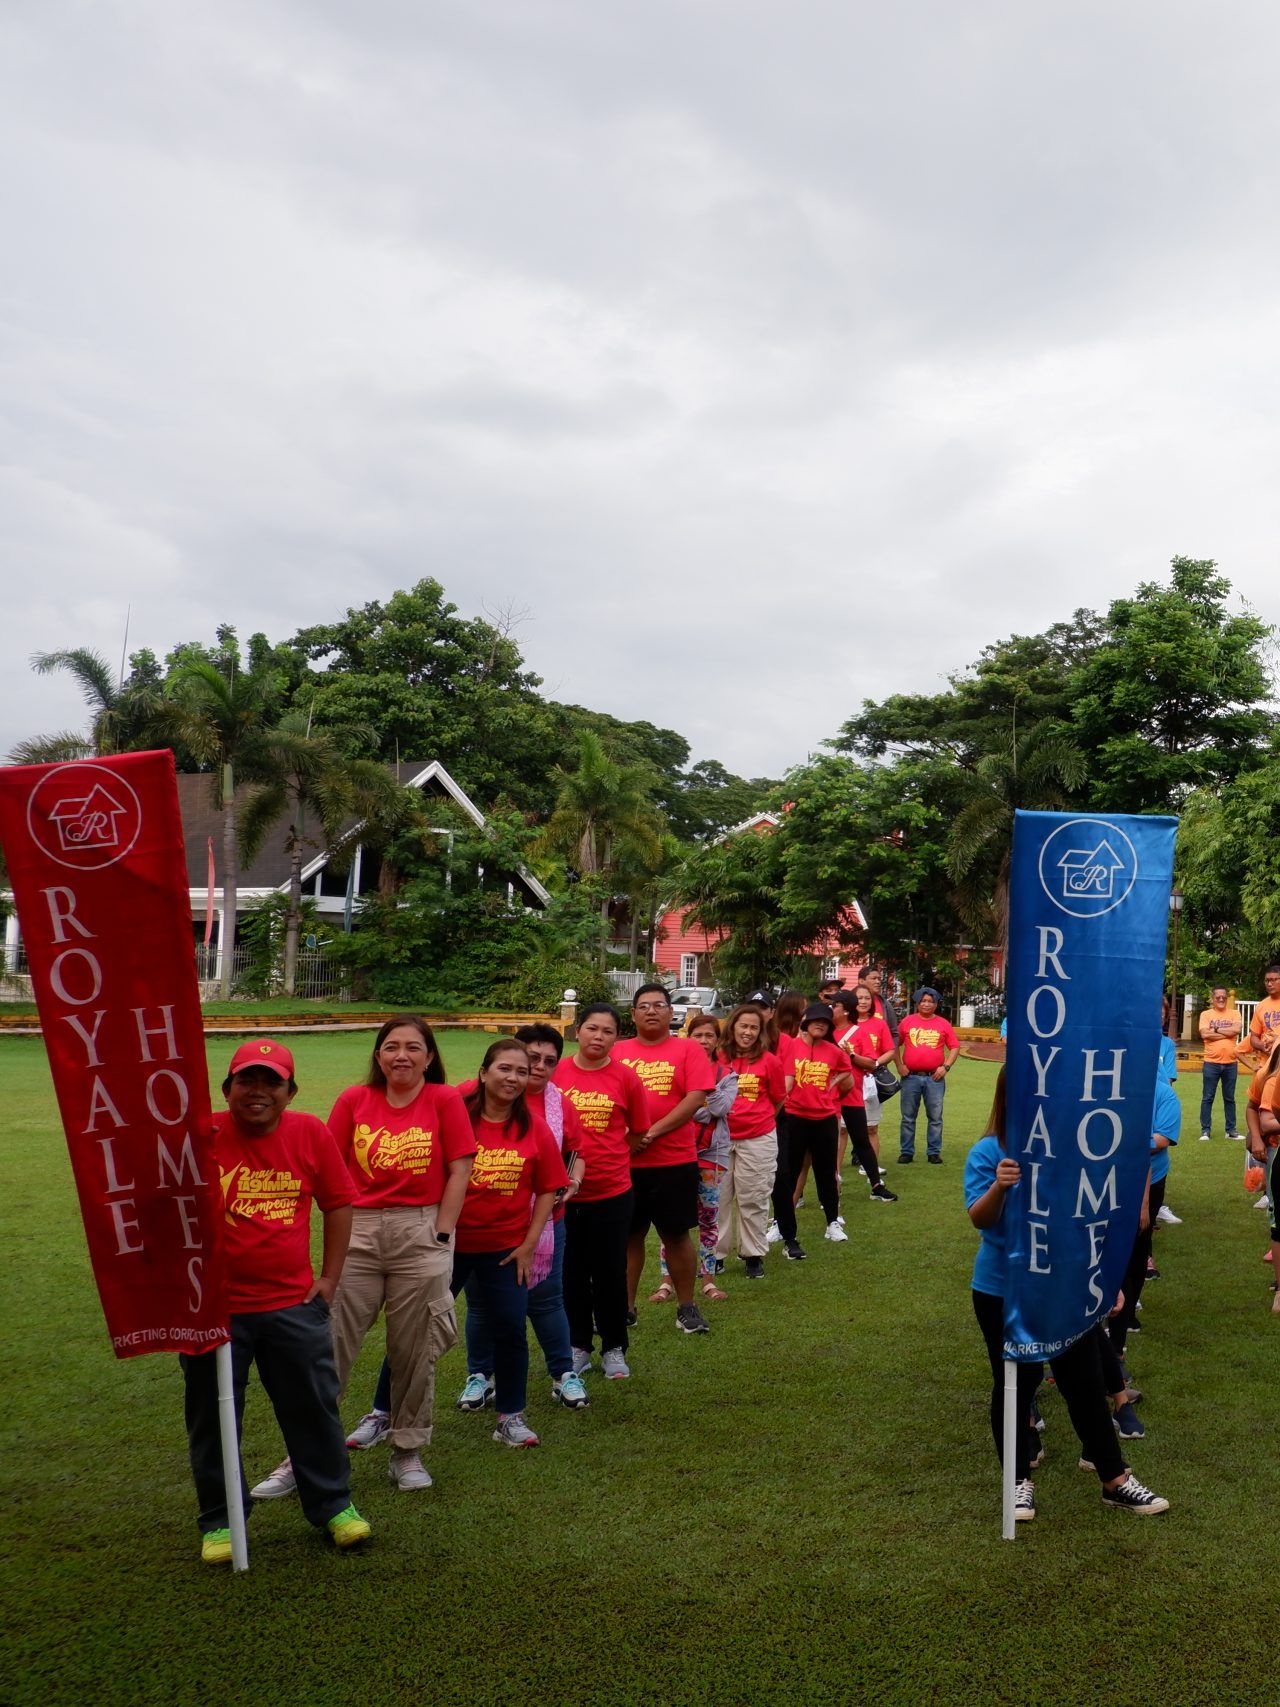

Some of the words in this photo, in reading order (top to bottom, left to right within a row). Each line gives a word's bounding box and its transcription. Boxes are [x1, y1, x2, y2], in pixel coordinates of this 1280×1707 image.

[41, 886, 144, 1256] ROYALE
[129, 1004, 208, 1314] HOMES
[1021, 925, 1073, 1275] ROYALE
[1072, 1048, 1127, 1318] HOMES
[113, 1328, 167, 1349] RKETING
